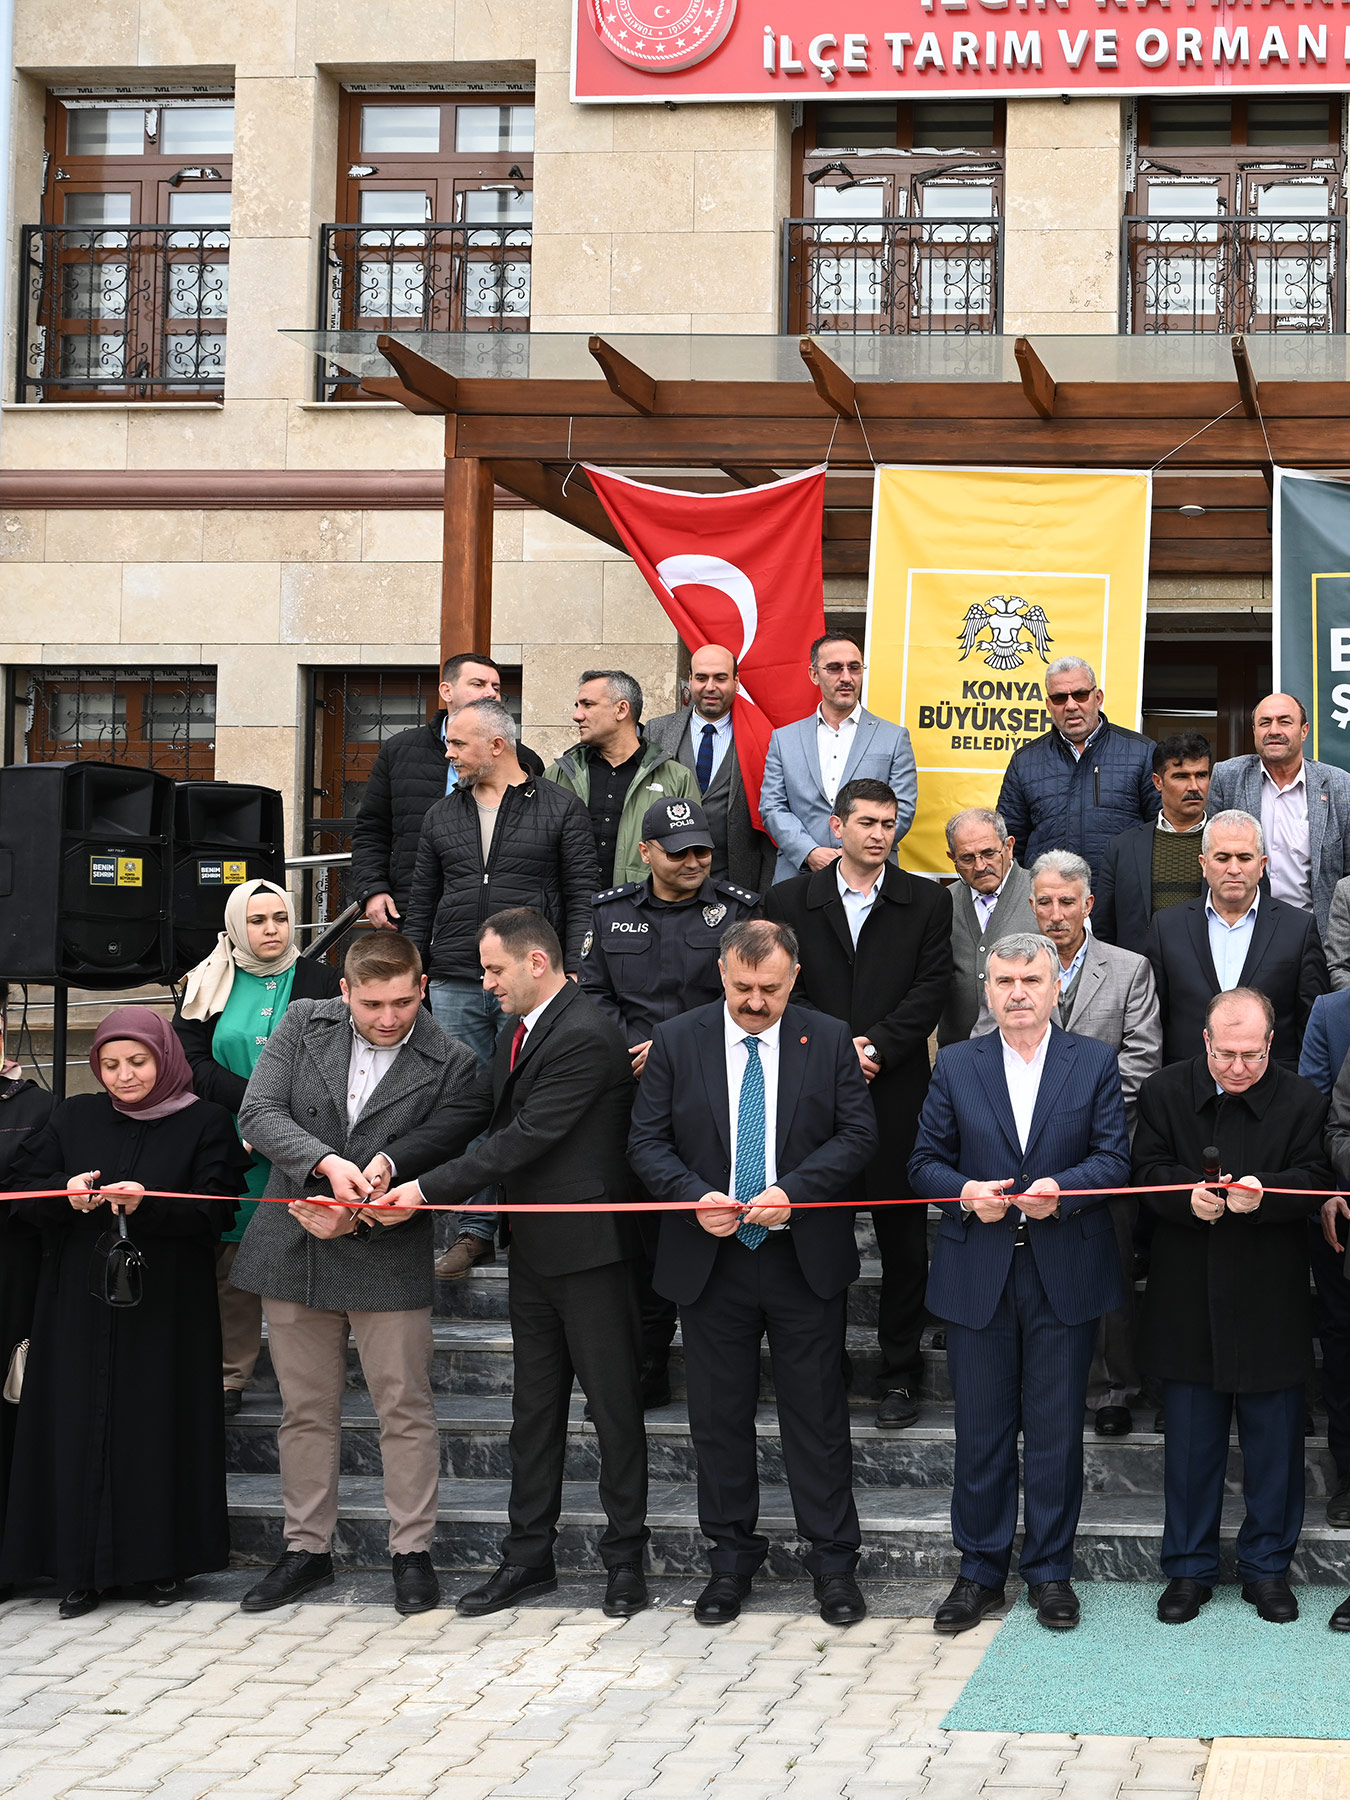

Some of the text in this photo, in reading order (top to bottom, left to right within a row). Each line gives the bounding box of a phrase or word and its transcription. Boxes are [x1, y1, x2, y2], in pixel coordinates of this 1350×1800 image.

[763, 25, 868, 83] İLÇE
[884, 29, 1043, 71] TARIM
[1057, 28, 1118, 69] VE
[1135, 24, 1327, 67] ORMAN
[961, 680, 1043, 702] KONYA
[918, 701, 1053, 736] BÜYÜKŞEH
